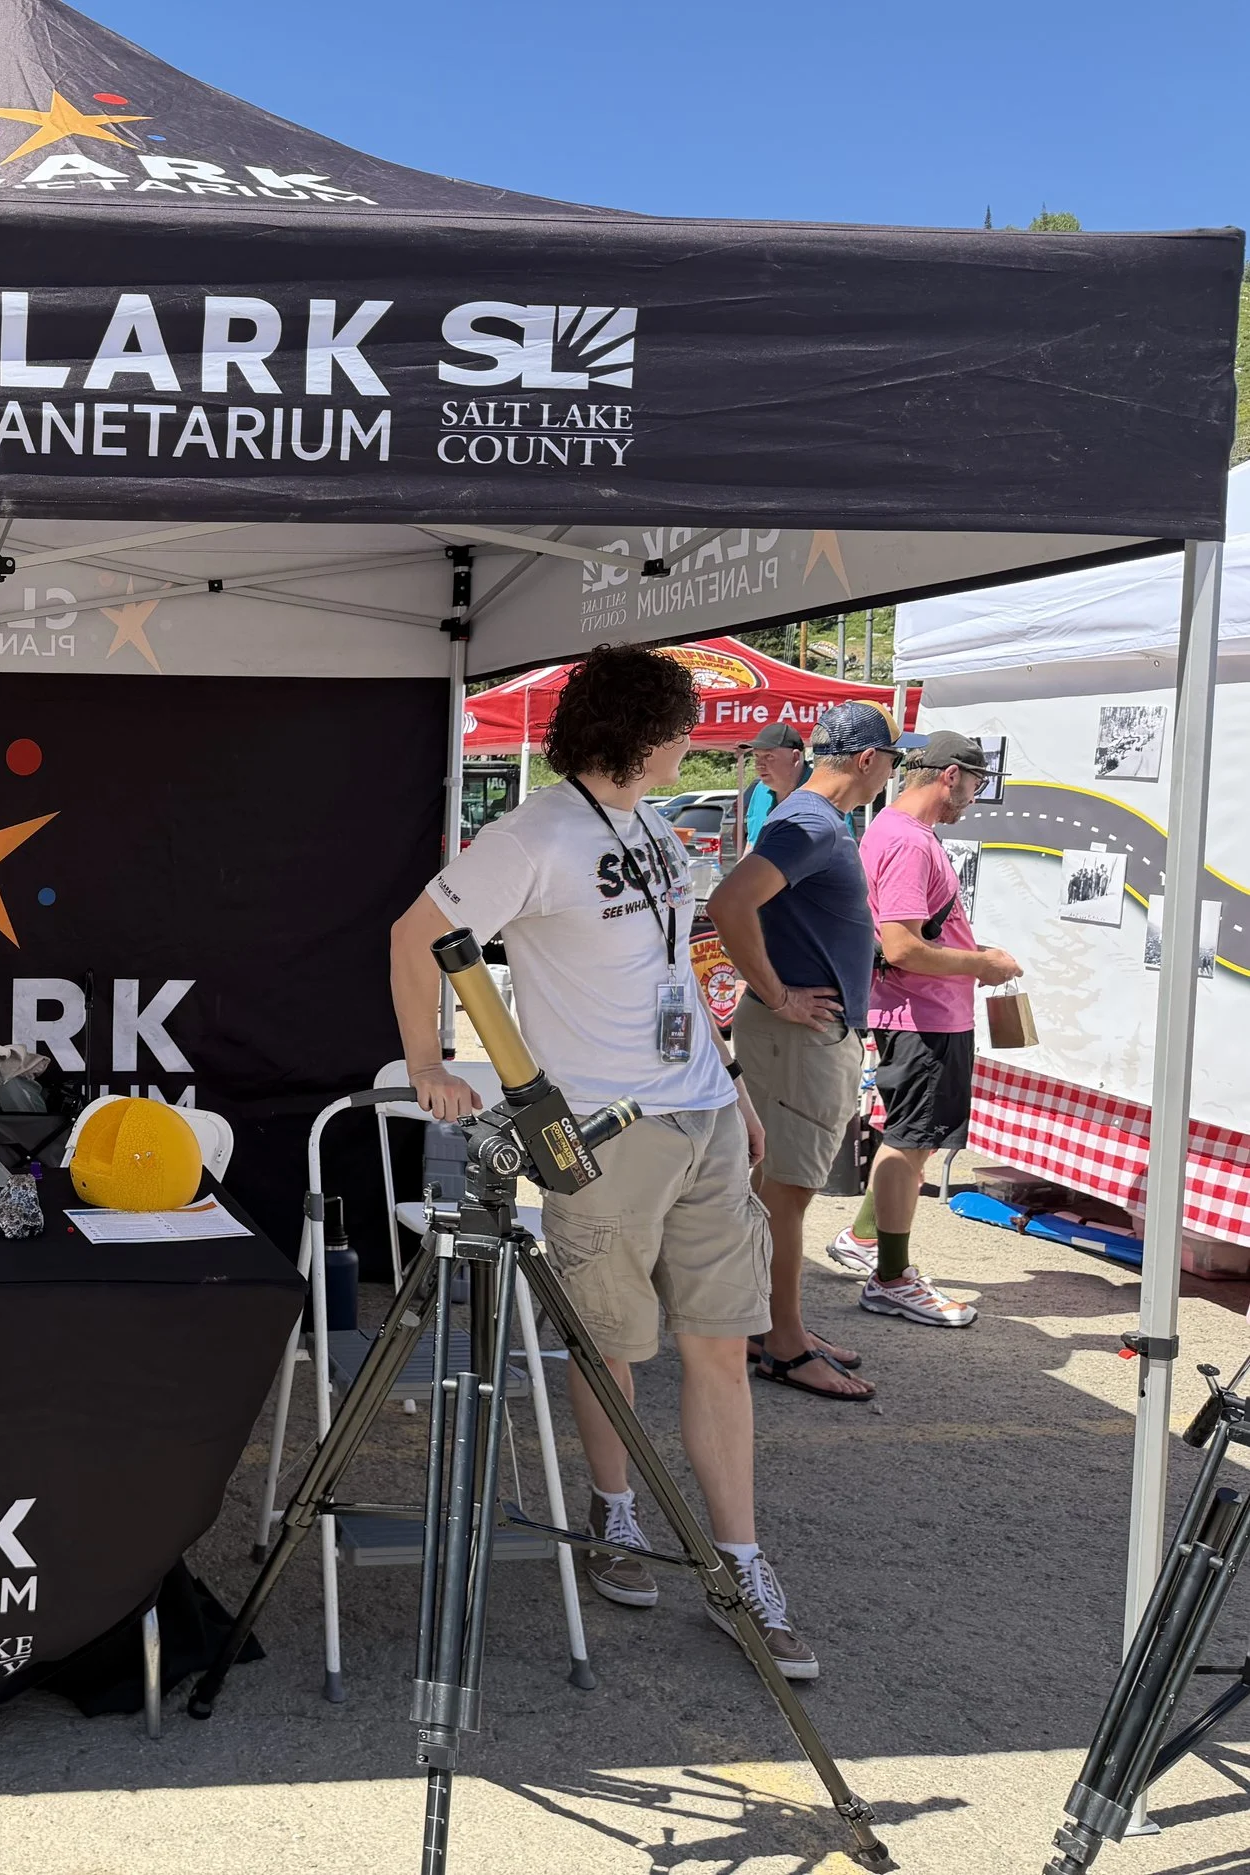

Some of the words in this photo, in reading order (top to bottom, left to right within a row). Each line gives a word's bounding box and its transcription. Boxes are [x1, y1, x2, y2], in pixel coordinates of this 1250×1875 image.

[12, 178, 379, 206] ETARIUM
[441, 400, 530, 428] SALT
[540, 403, 633, 430] LAKE
[437, 435, 635, 467] COUNTY
[716, 701, 768, 723] Fire
[602, 905, 623, 920] SEE
[561, 1117, 597, 1179] CORONADO
